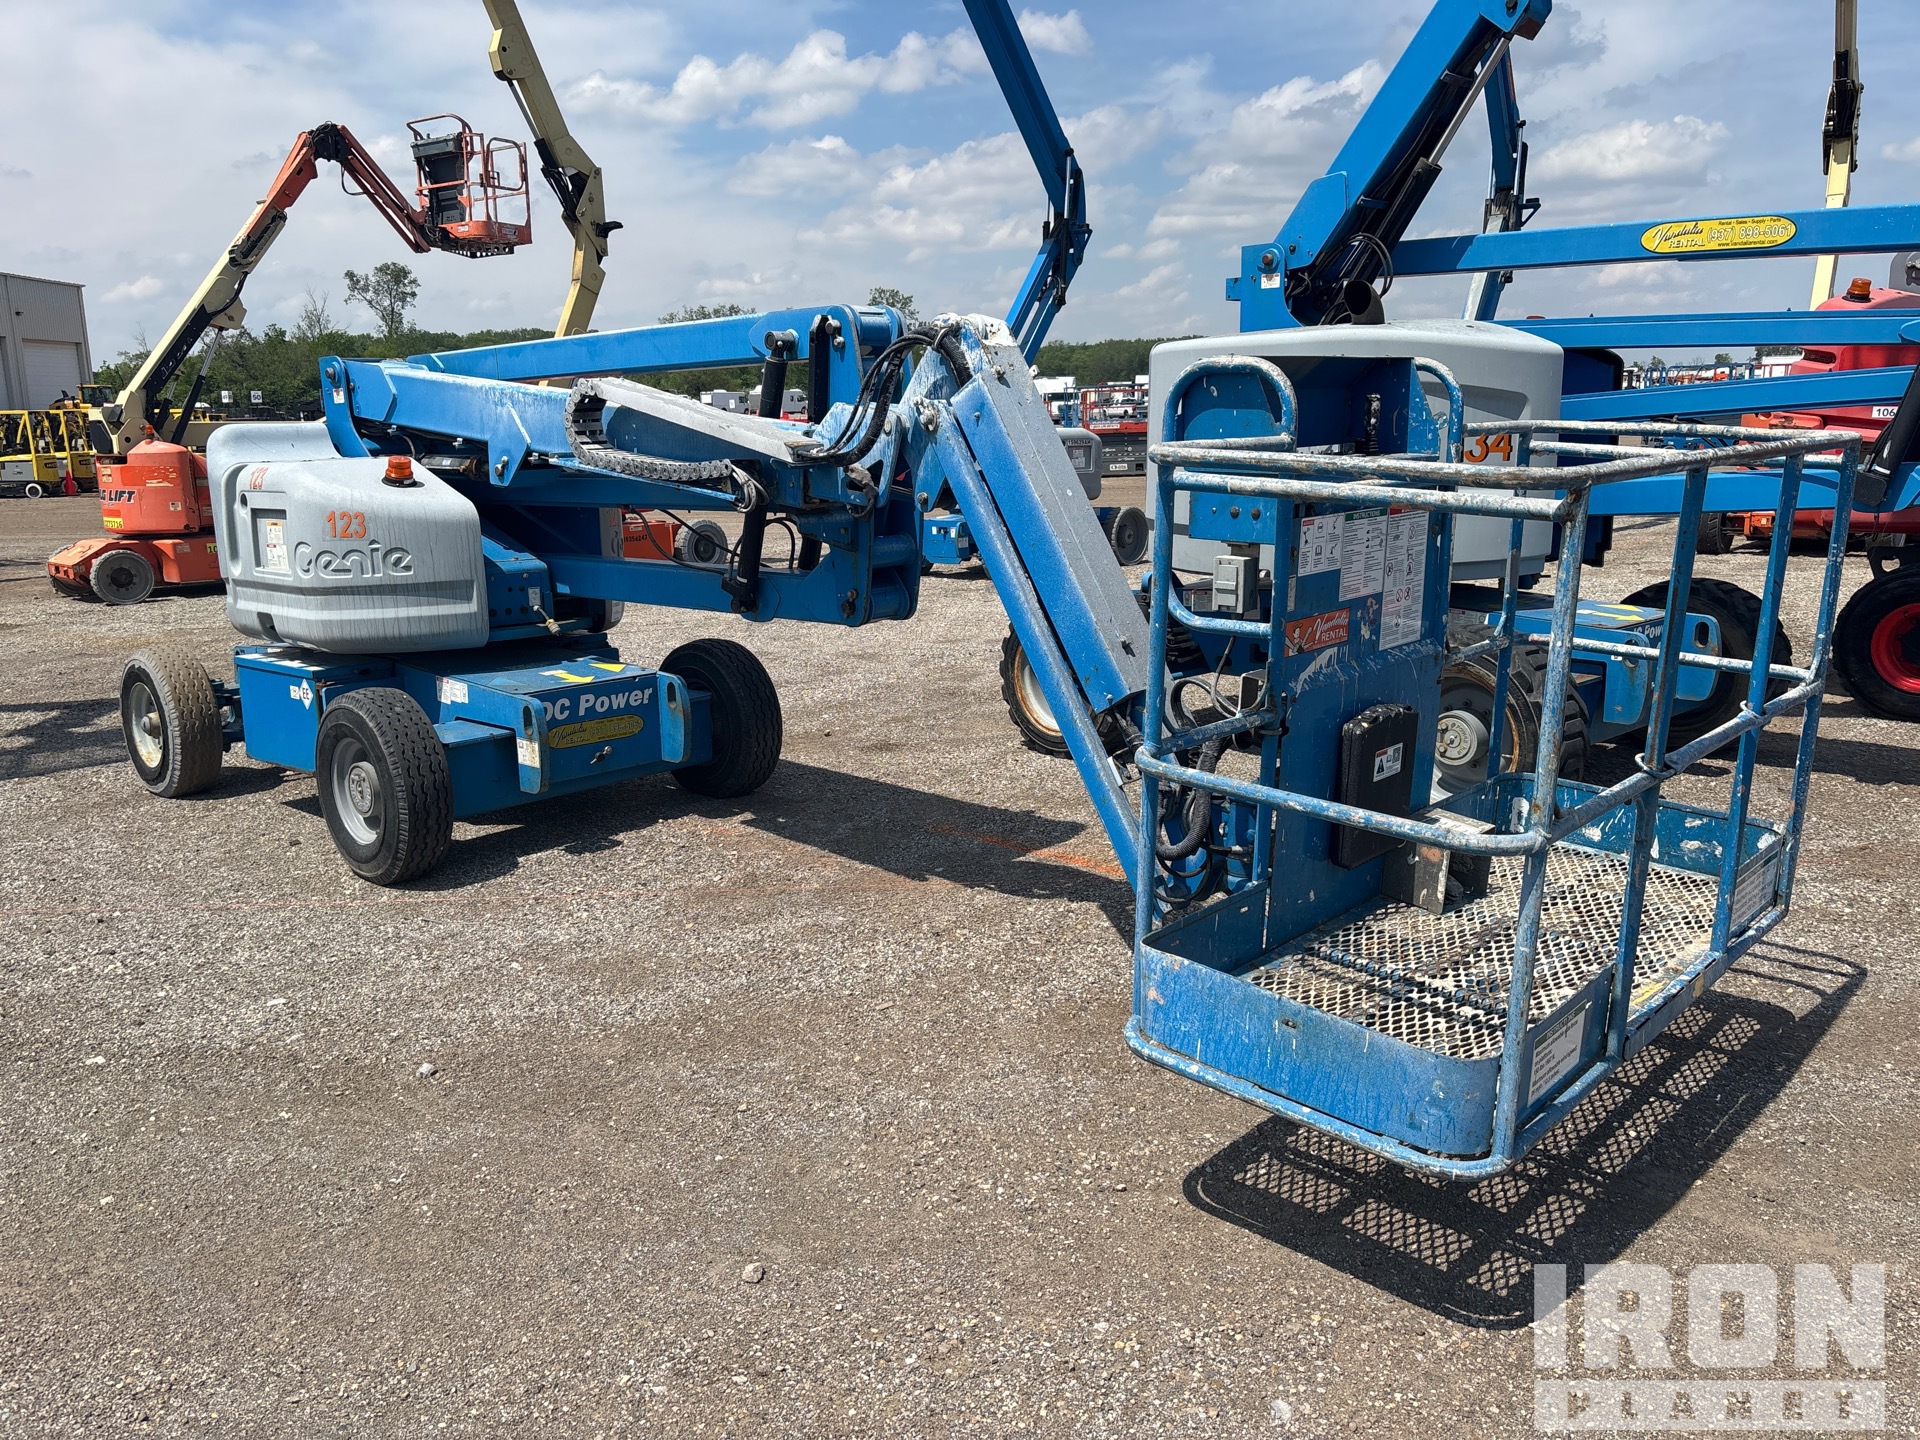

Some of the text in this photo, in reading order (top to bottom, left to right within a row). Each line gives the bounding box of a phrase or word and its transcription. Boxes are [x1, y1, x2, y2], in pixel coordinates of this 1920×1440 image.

[1652, 222, 1703, 250] Vandalia
[1707, 223, 1791, 243] (937) 898-5061
[1668, 239, 1705, 248] RENTAL
[108, 490, 136, 502] LIFT
[1353, 510, 1380, 519] INSTRUCTIONS
[325, 511, 367, 539] 123
[294, 539, 413, 579] Genie
[1313, 610, 1349, 644] Vandalia
[1321, 628, 1348, 641] RENTAL
[302, 687, 310, 700] EE
[543, 687, 653, 722] DC Power
